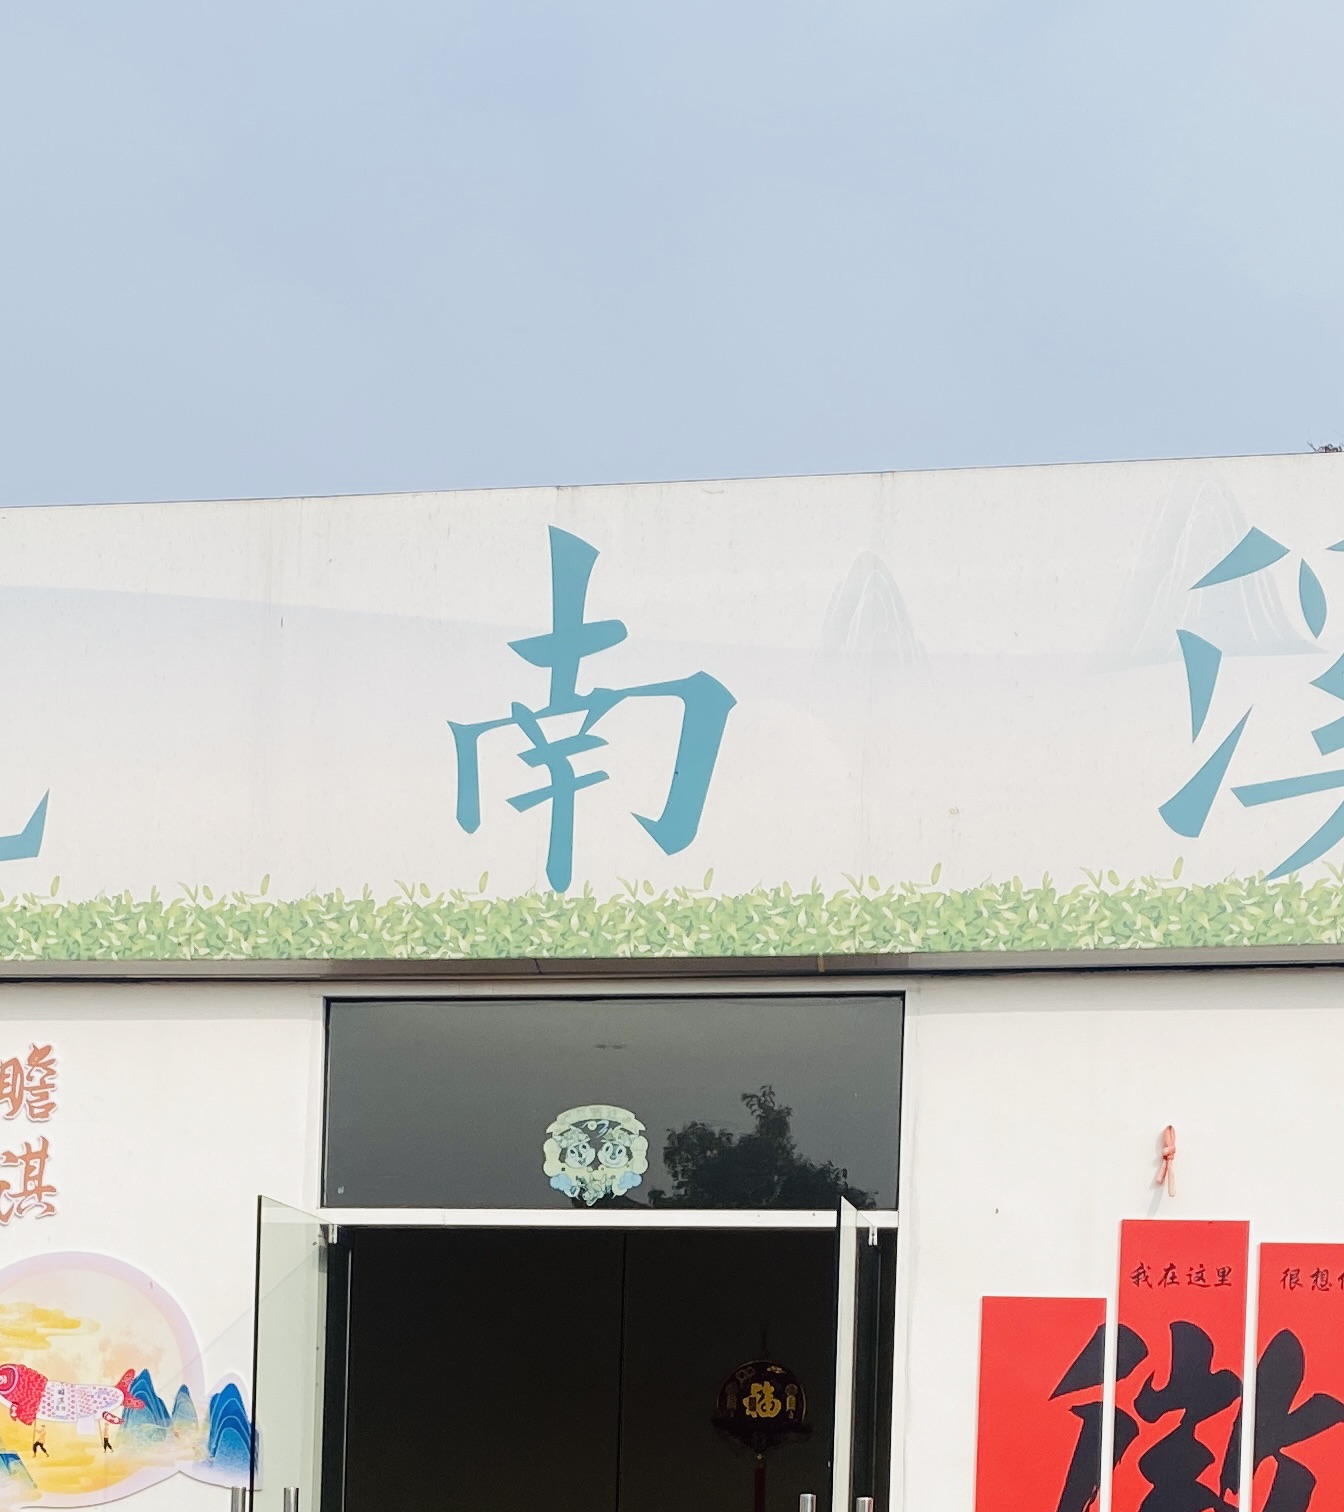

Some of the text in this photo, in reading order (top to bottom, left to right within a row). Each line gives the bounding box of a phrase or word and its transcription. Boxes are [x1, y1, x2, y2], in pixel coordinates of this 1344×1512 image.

[1130, 1261, 1233, 1289] 我在这里
[742, 1380, 782, 1418] 福
